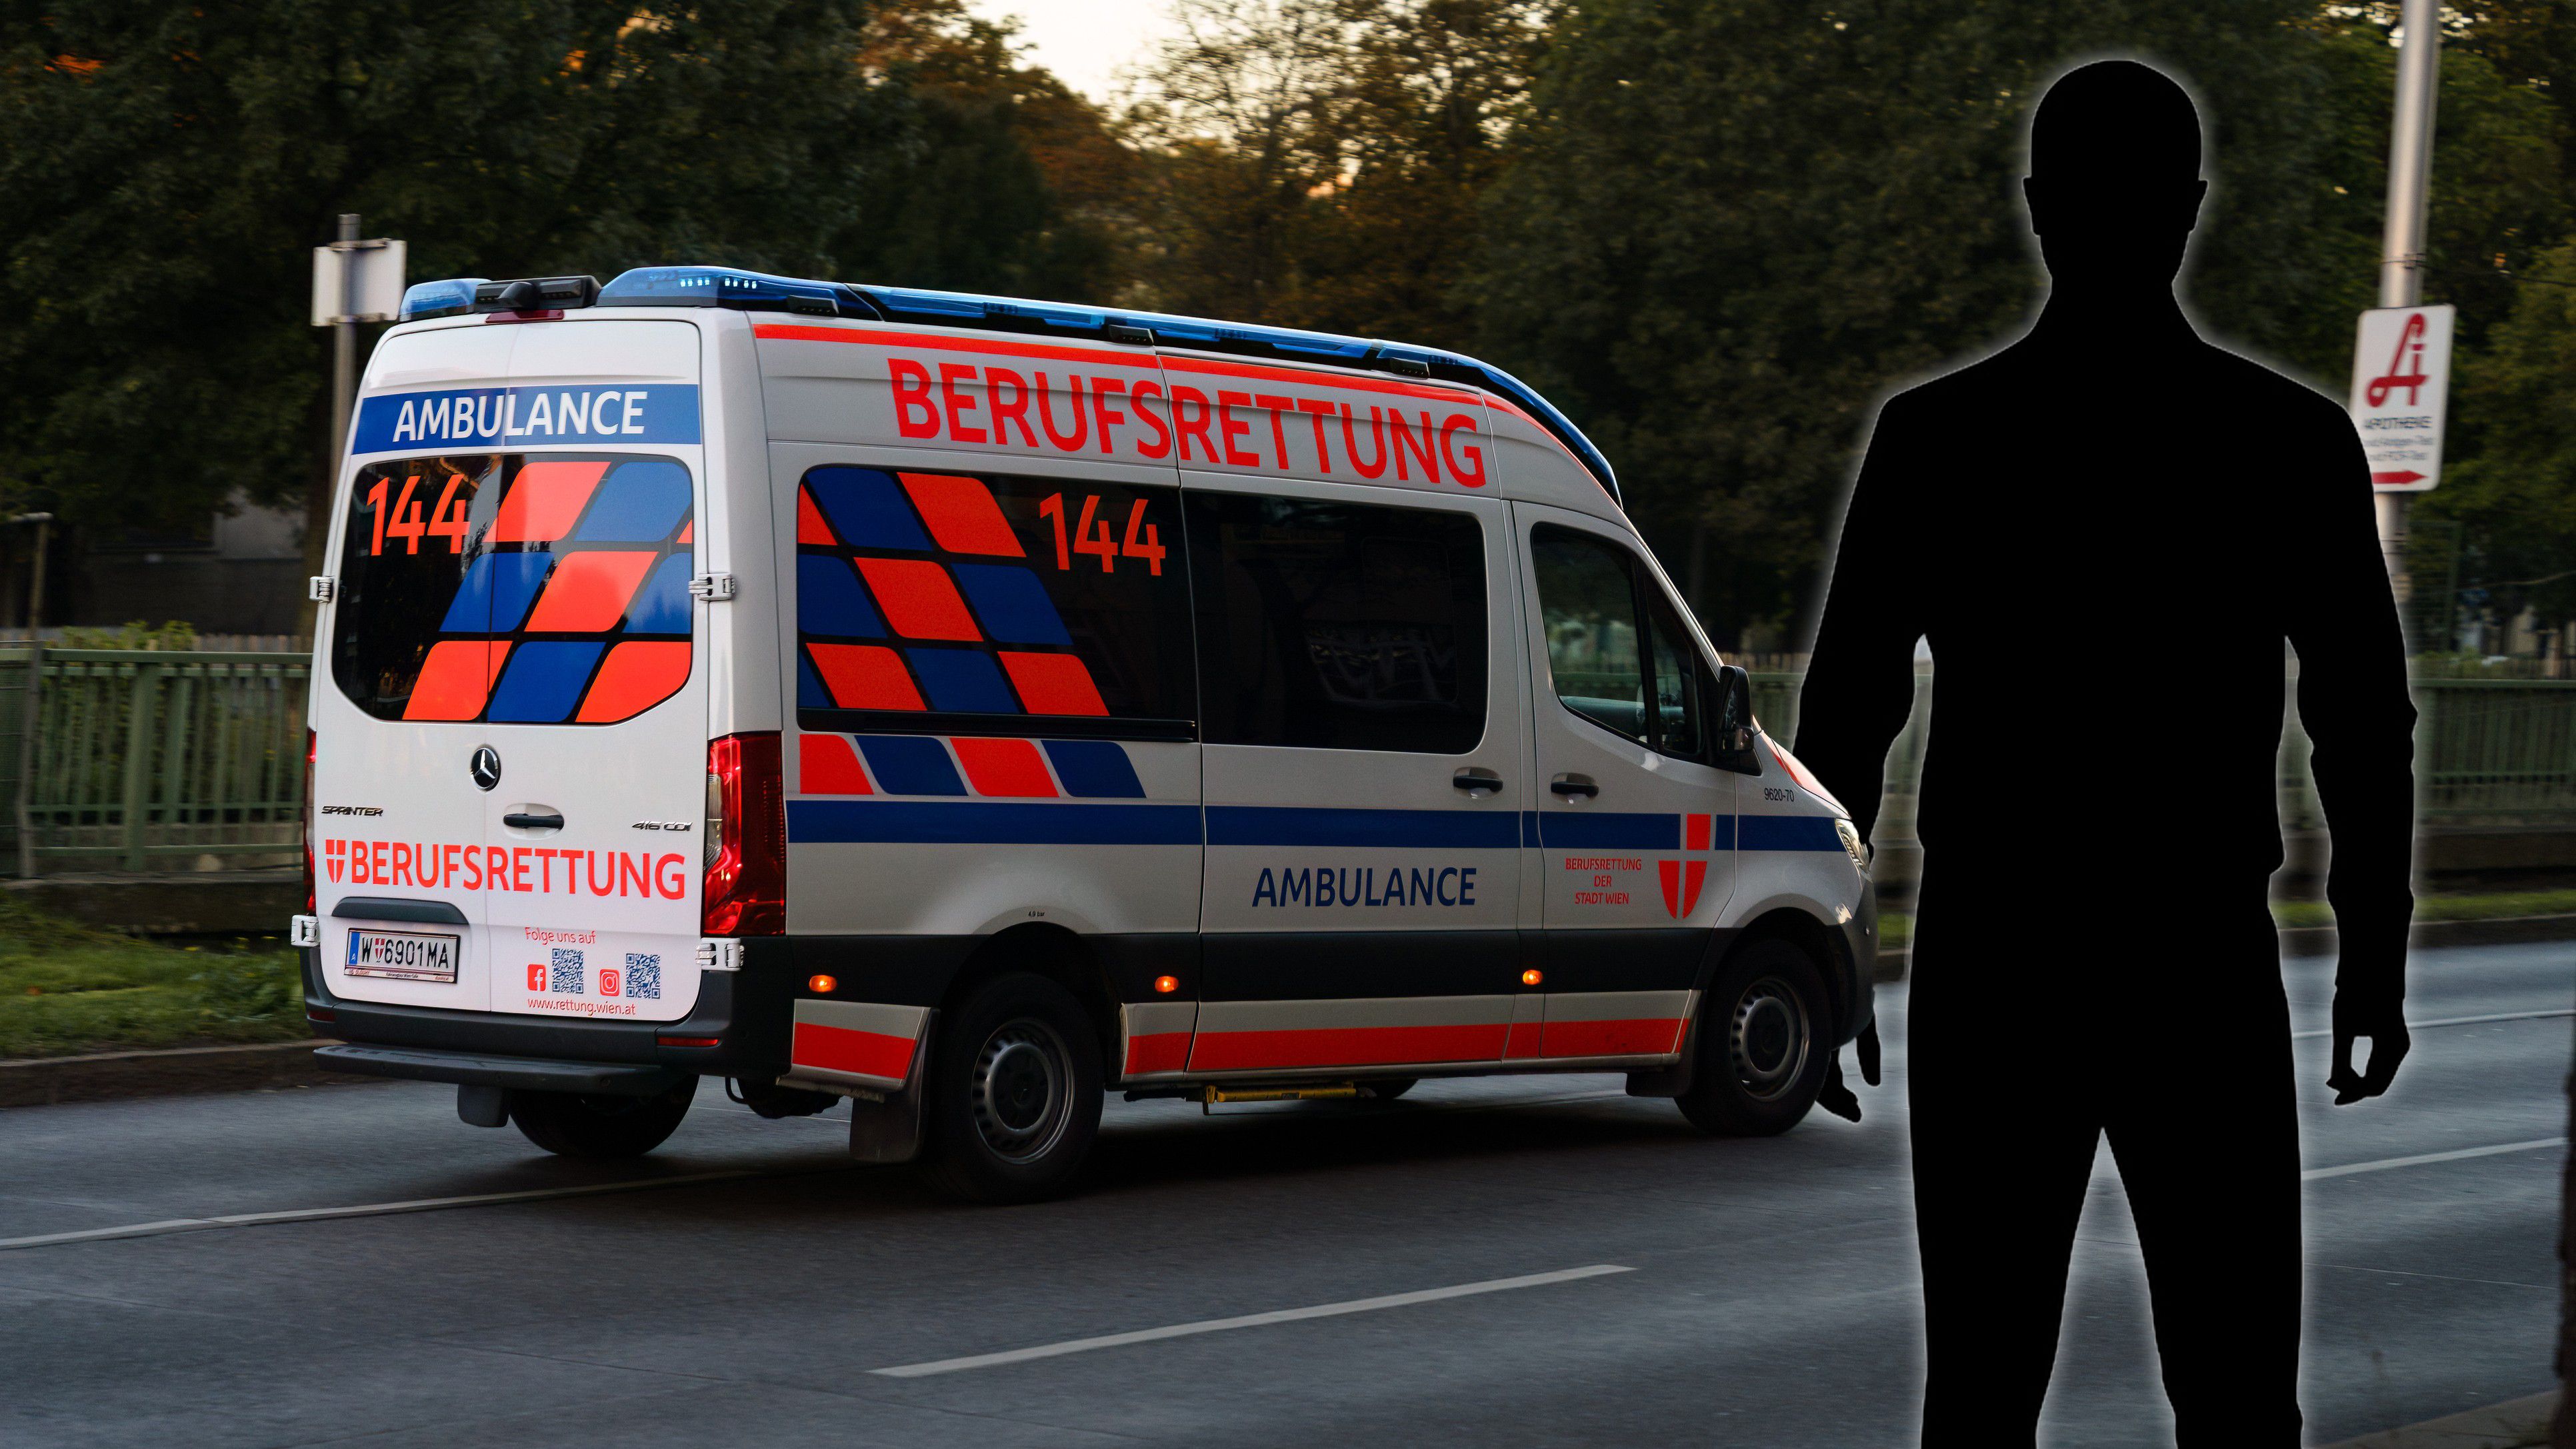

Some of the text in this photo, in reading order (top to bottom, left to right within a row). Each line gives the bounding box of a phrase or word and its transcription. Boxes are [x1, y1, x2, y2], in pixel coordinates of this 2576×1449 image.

[393, 391, 648, 443] AMBULANCE
[887, 358, 1486, 489] BERUFSRETTUNG
[367, 474, 470, 556] 144
[1039, 492, 1166, 577] 144
[1764, 787, 1795, 802] 9620-70
[321, 805, 383, 816] SPRINTER
[631, 820, 693, 831] 416 CDI
[351, 840, 686, 900] BERUFSRETTUNG
[1565, 858, 1641, 870] BERUFSRETTUNG
[1252, 867, 1477, 907] AMBULANCE
[1594, 875, 1612, 887] DER
[1575, 892, 1629, 904] STADT WIEN
[525, 927, 596, 945] Folge uns auf
[527, 998, 636, 1016] www.rettung.wien.at
